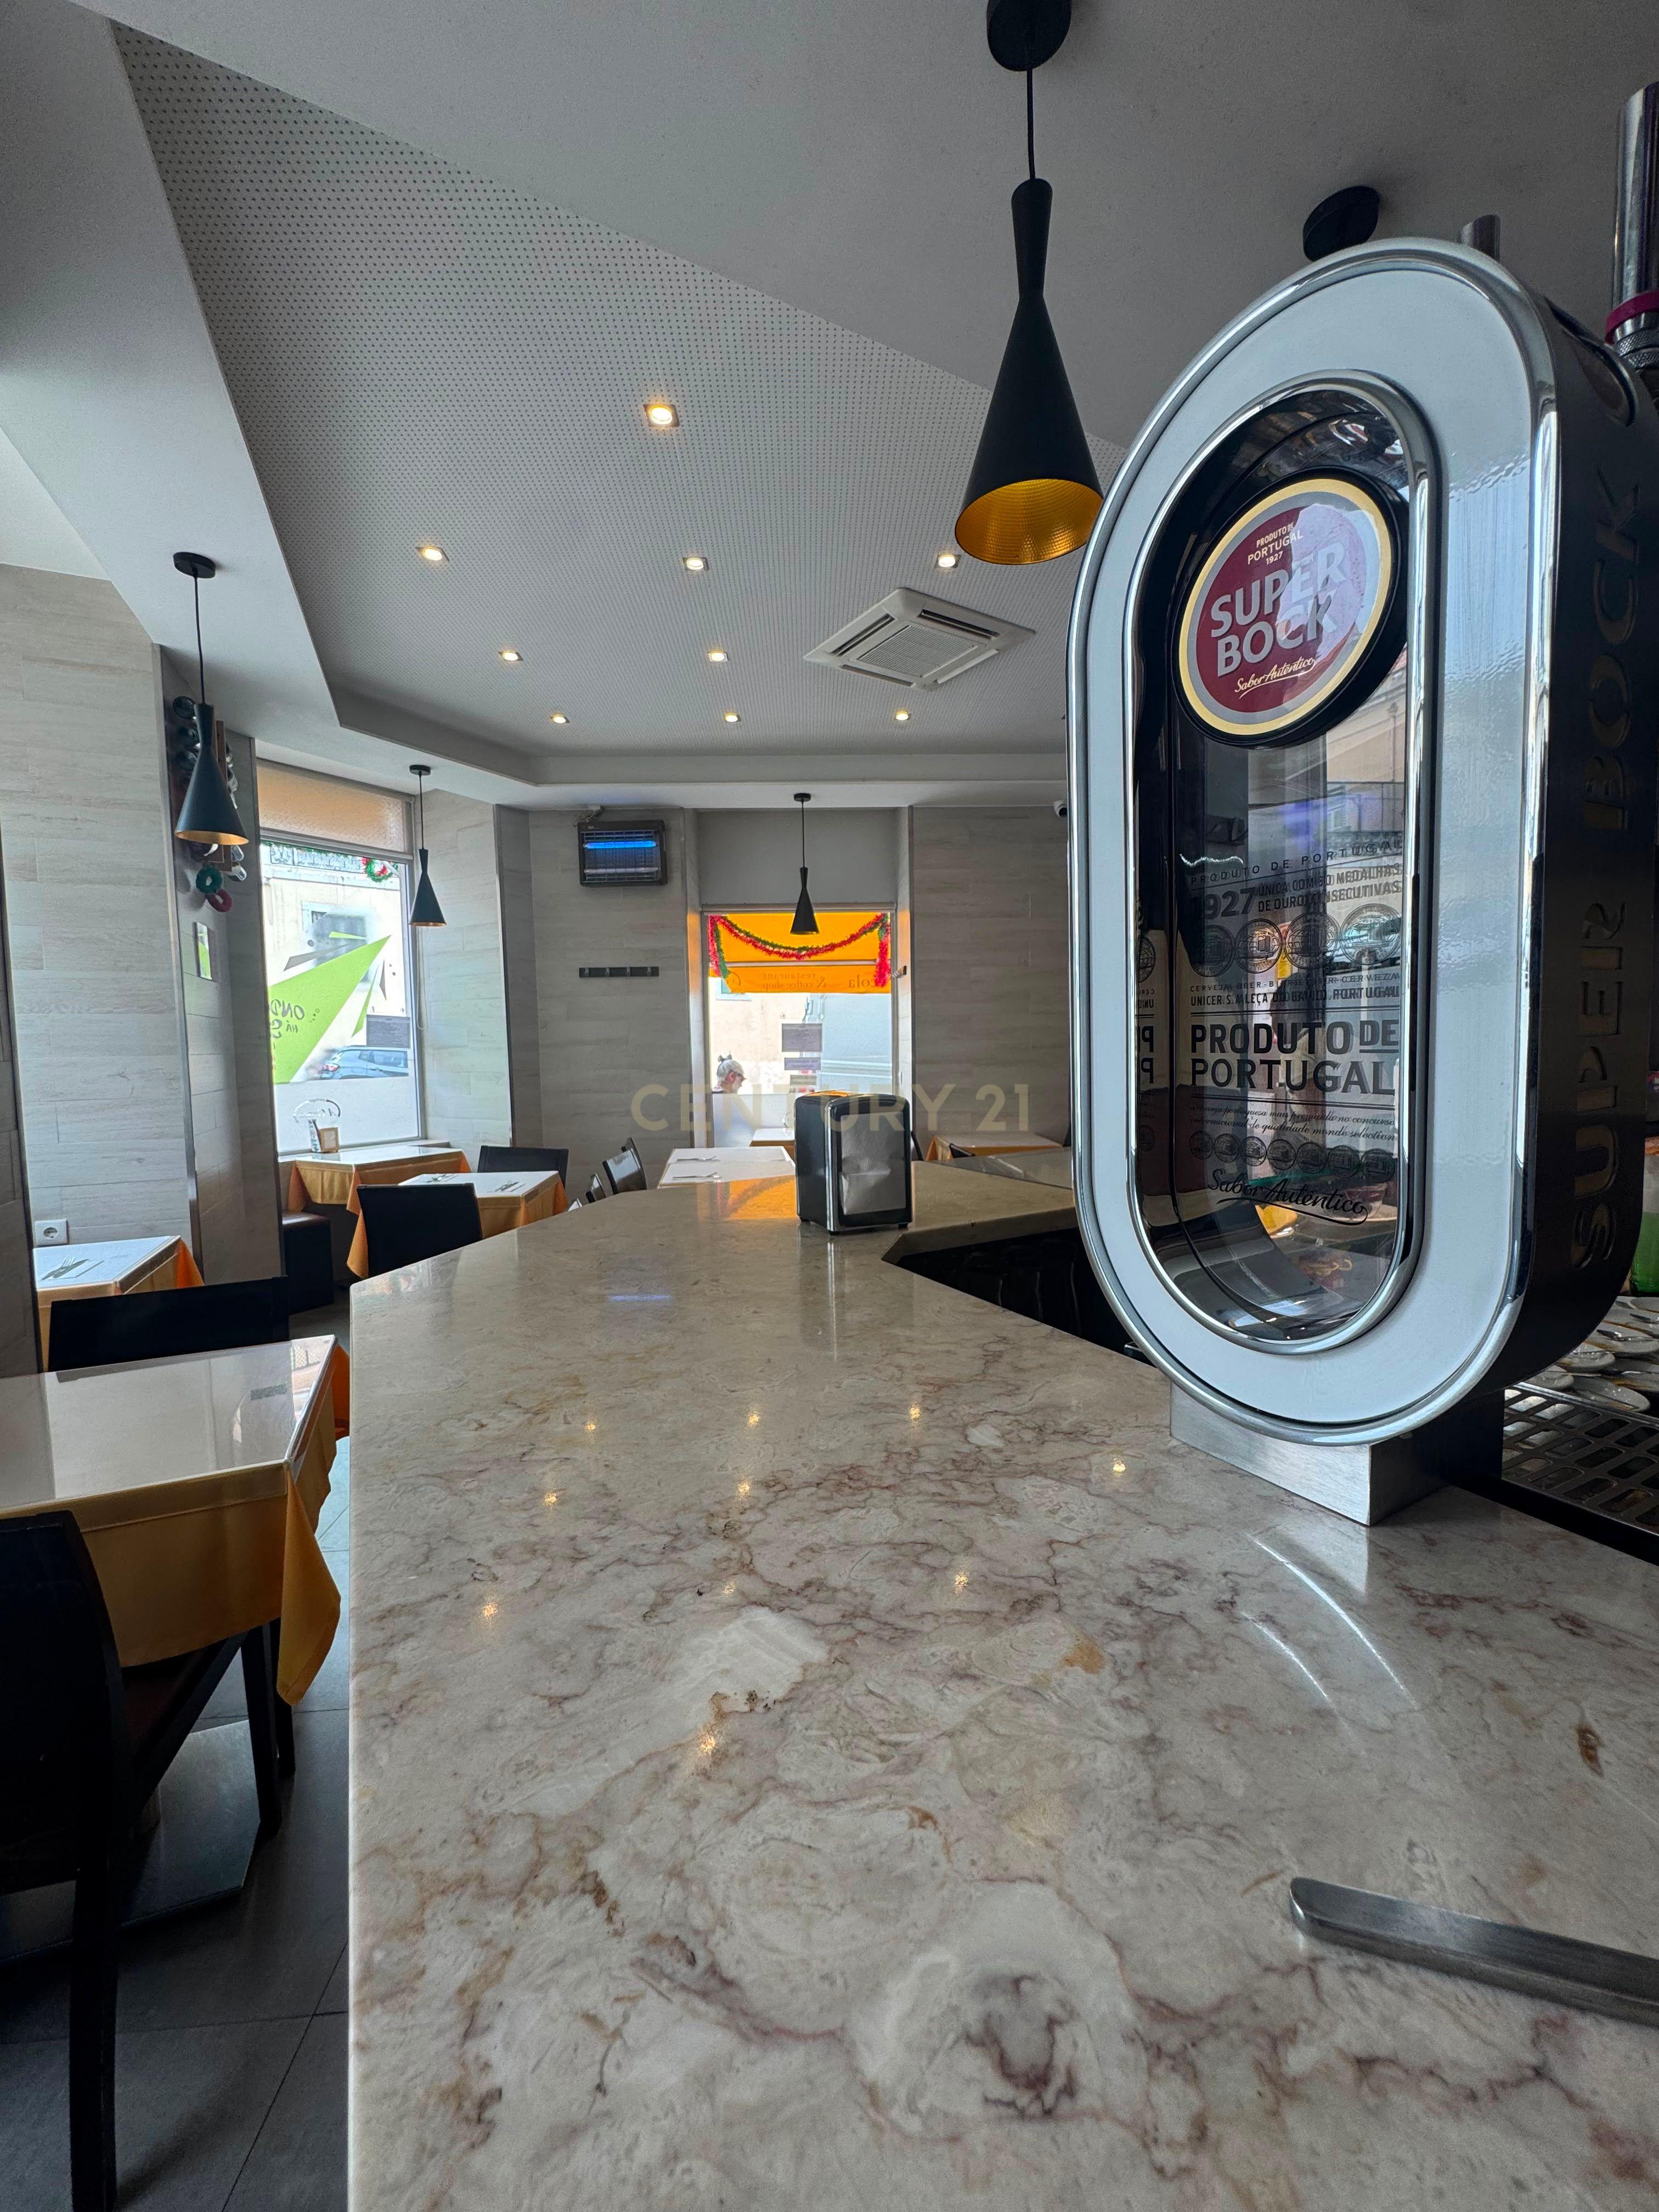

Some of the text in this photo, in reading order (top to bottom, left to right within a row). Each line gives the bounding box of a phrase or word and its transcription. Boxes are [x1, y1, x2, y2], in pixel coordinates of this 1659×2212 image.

[1247, 529, 1304, 565] PORTUGAL
[1256, 522, 1294, 548] PRODUTO DE
[1266, 550, 1284, 565] 1927
[1211, 542, 1346, 638] SUPER
[1217, 589, 1338, 678] BOCK
[1234, 673, 1266, 693] Sabor
[1190, 840, 1403, 885] PRODUTO DE PORTUGAL
[1336, 862, 1402, 885] MEDALHAS
[1571, 466, 1639, 1272] SUPER BOCK
[1258, 900, 1271, 912] DE
[1273, 895, 1305, 910] OURO
[1190, 995, 1222, 1007] UNICER
[1190, 1019, 1399, 1055] PRODUTO DE
[1190, 1057, 1396, 1096] PORTUGAL
[1249, 1118, 1261, 1129] de
[1206, 1168, 1265, 1197] Sabor
